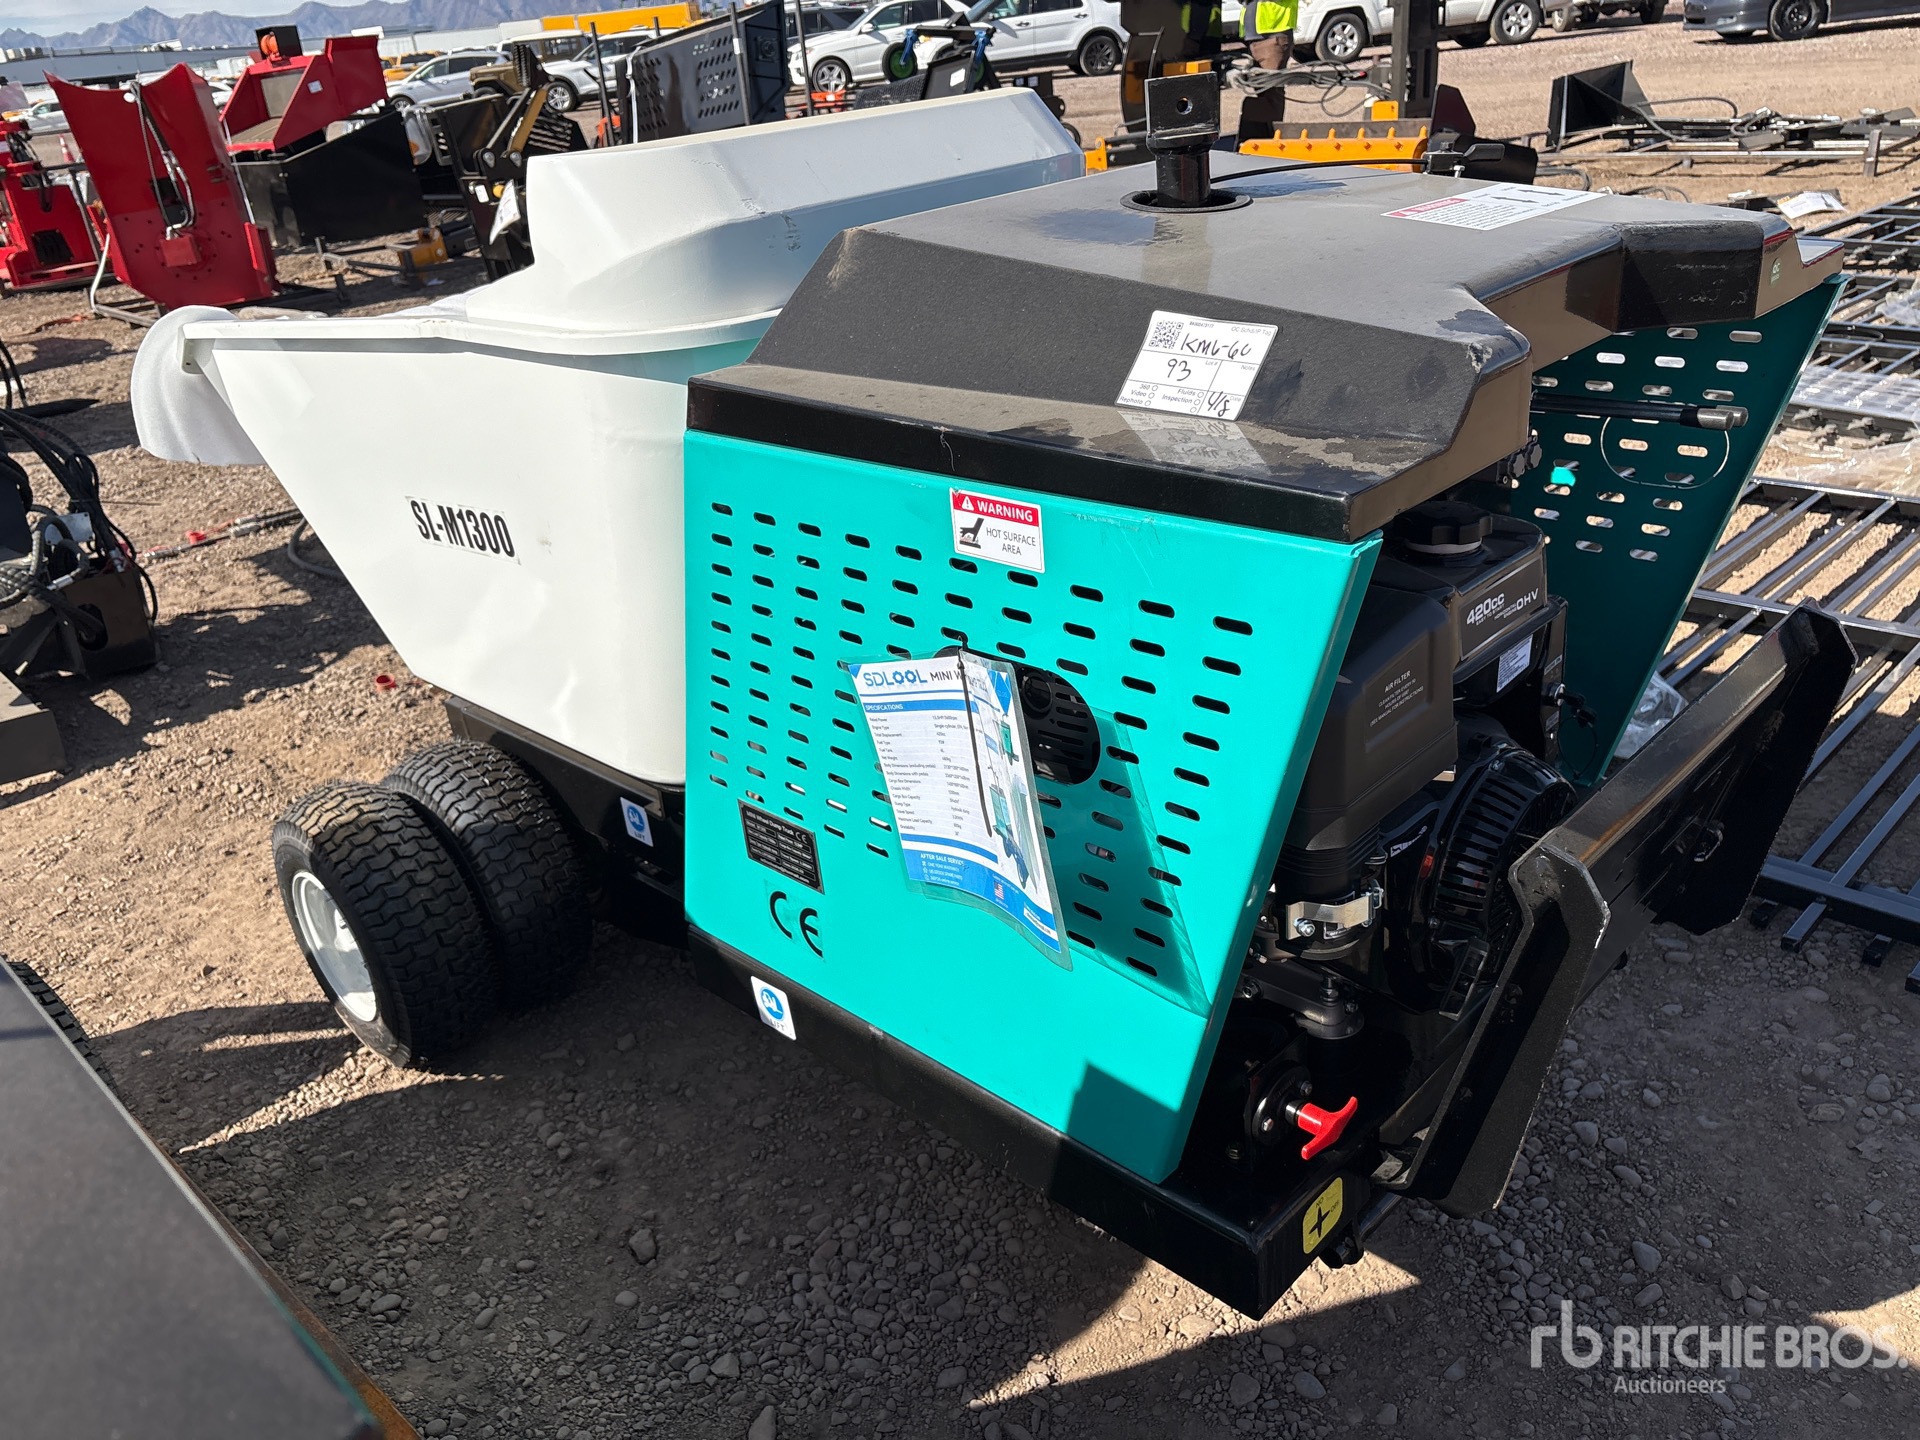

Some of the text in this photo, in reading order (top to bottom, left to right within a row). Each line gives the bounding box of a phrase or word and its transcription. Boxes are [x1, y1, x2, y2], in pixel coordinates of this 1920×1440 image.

[1167, 358, 1192, 382] 93
[1131, 389, 1147, 397] Video
[1139, 383, 1151, 391] 360
[1177, 388, 1196, 397] Fluids
[1162, 393, 1193, 404] Inspection
[976, 499, 1034, 523] WARNING
[410, 499, 516, 558] SL-M1300
[986, 526, 1037, 547] HOT SURFACE
[1001, 543, 1022, 556] AREA
[1466, 592, 1505, 625] 420cc
[1516, 587, 1539, 611] OHV
[863, 669, 928, 687] SDLOOL
[929, 670, 952, 682] MINI
[1384, 670, 1411, 693] AIR FILTER
[920, 852, 935, 860] AFTER
[935, 855, 947, 863] SALE
[769, 890, 823, 958] CE
